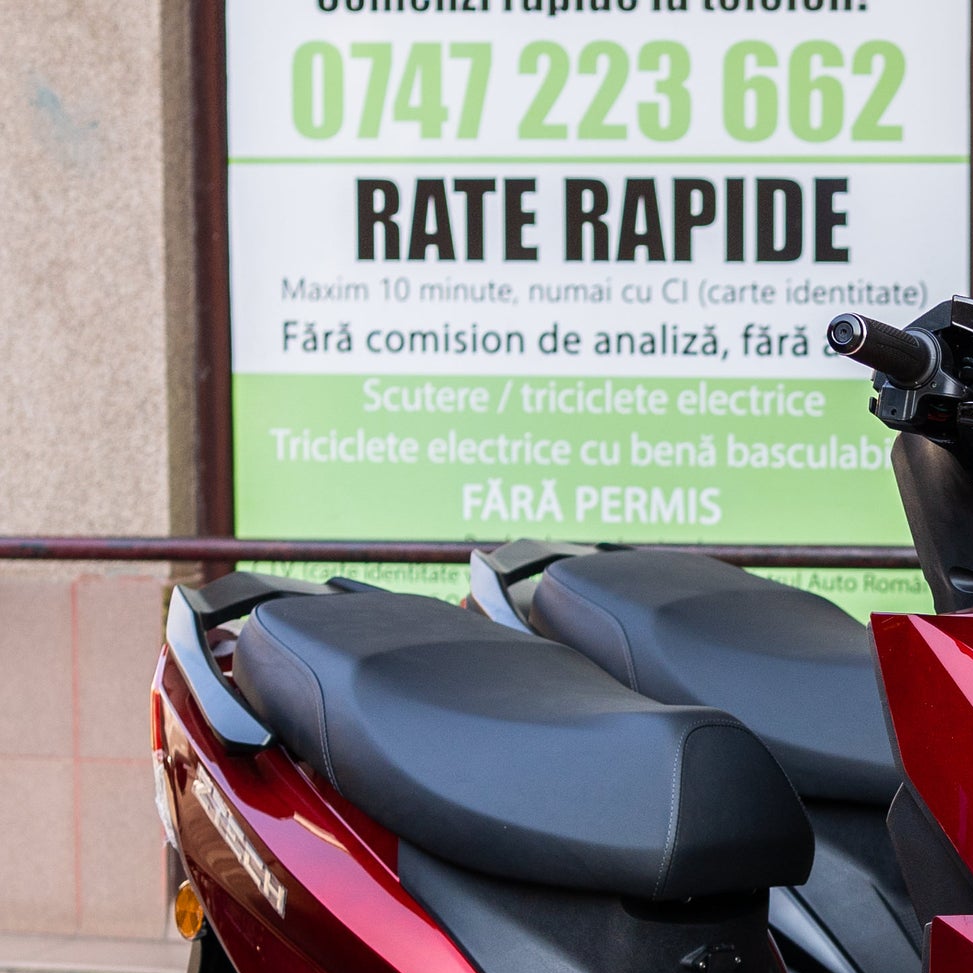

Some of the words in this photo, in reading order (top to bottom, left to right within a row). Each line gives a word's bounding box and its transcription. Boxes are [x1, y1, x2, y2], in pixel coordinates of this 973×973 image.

[292, 41, 492, 140] 0747
[518, 40, 692, 142] 223
[722, 39, 907, 144] 662
[355, 177, 539, 262] RATE
[563, 176, 851, 264] RAPIDE
[282, 277, 368, 302] Maxim
[381, 277, 410, 302] 10
[419, 278, 514, 306] minute,
[529, 278, 611, 304] numai
[621, 284, 652, 304] cu
[662, 278, 688, 304] CI
[698, 280, 777, 307] (carte
[785, 279, 929, 309] identitate)
[283, 320, 352, 353] Fără
[366, 322, 524, 356] comision
[538, 321, 581, 356] de
[594, 323, 728, 361] analiză,
[741, 322, 810, 358] fără
[363, 379, 488, 412] Scutere
[521, 381, 667, 414] triciclete
[678, 382, 825, 416] electrice
[270, 429, 418, 463] Triciclete
[428, 431, 571, 465] electrice
[581, 441, 619, 465] cu
[632, 433, 716, 467] benă
[462, 478, 562, 522] FĂRĂ
[577, 487, 721, 525] PERMIS
[807, 573, 858, 593] Auto
